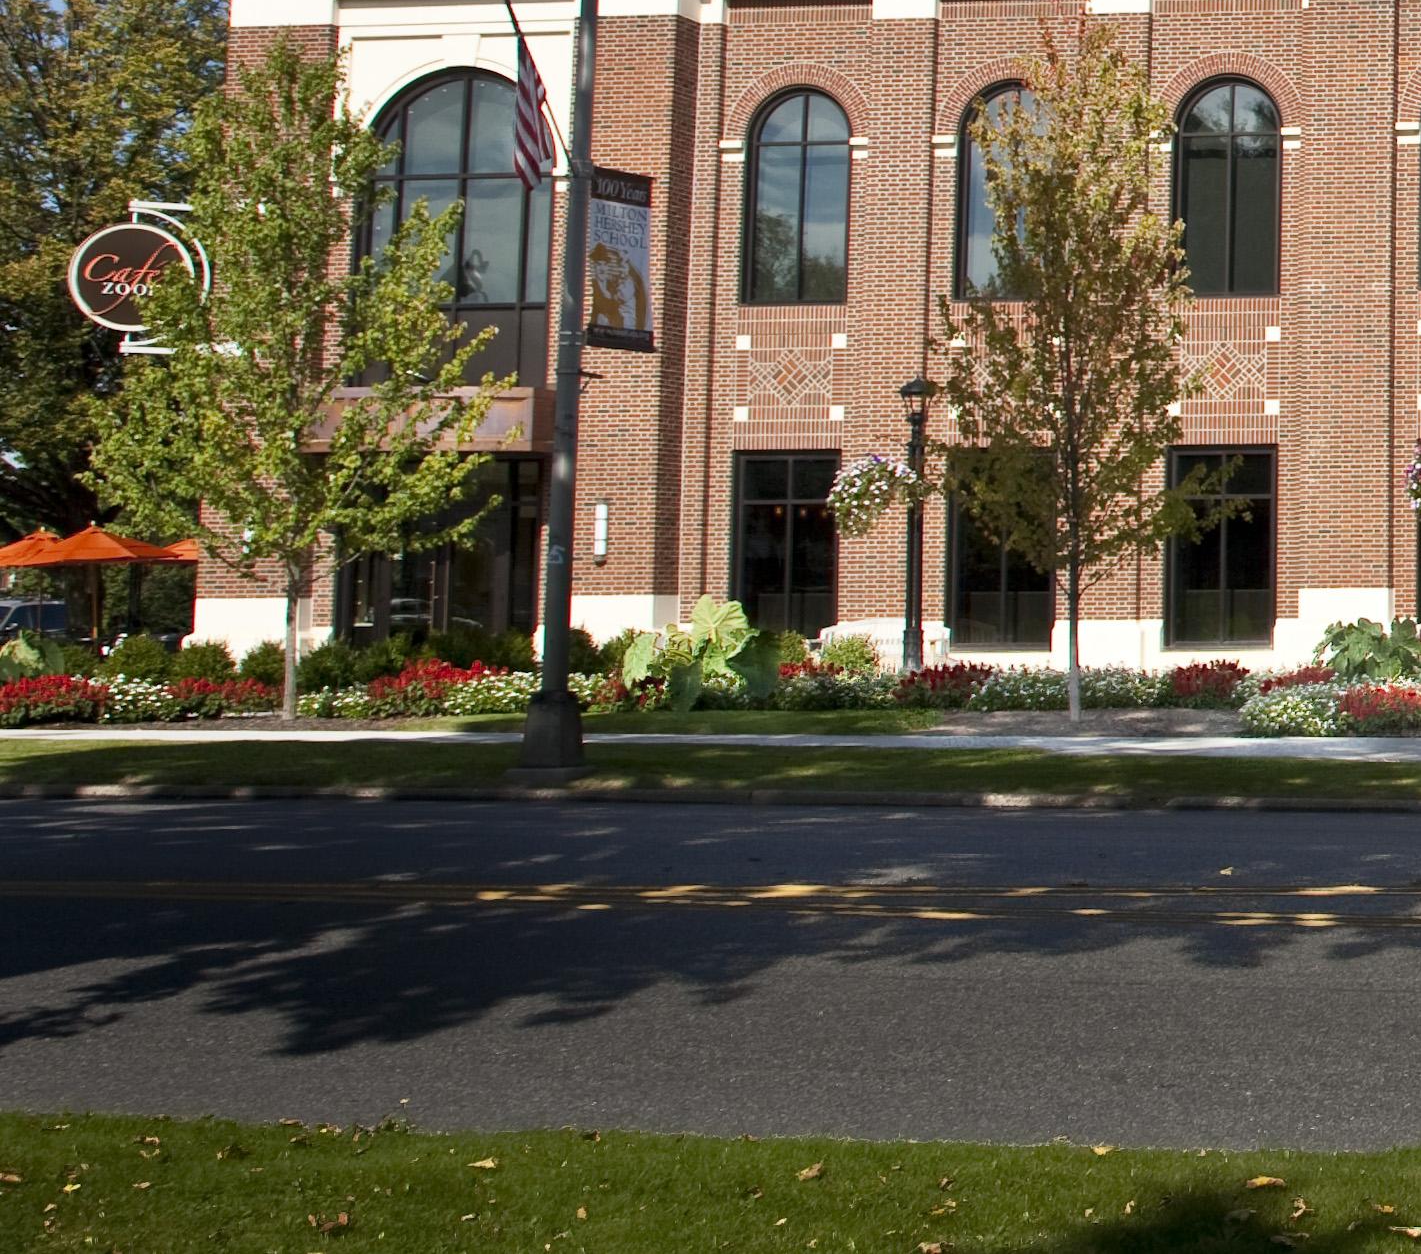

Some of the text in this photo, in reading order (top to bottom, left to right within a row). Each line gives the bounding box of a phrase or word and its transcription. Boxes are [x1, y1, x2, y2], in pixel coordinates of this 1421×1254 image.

[596, 176, 620, 197] 100
[595, 201, 648, 223] MILTON
[594, 215, 647, 236] HERSHEY
[593, 229, 648, 250] SCHOOL
